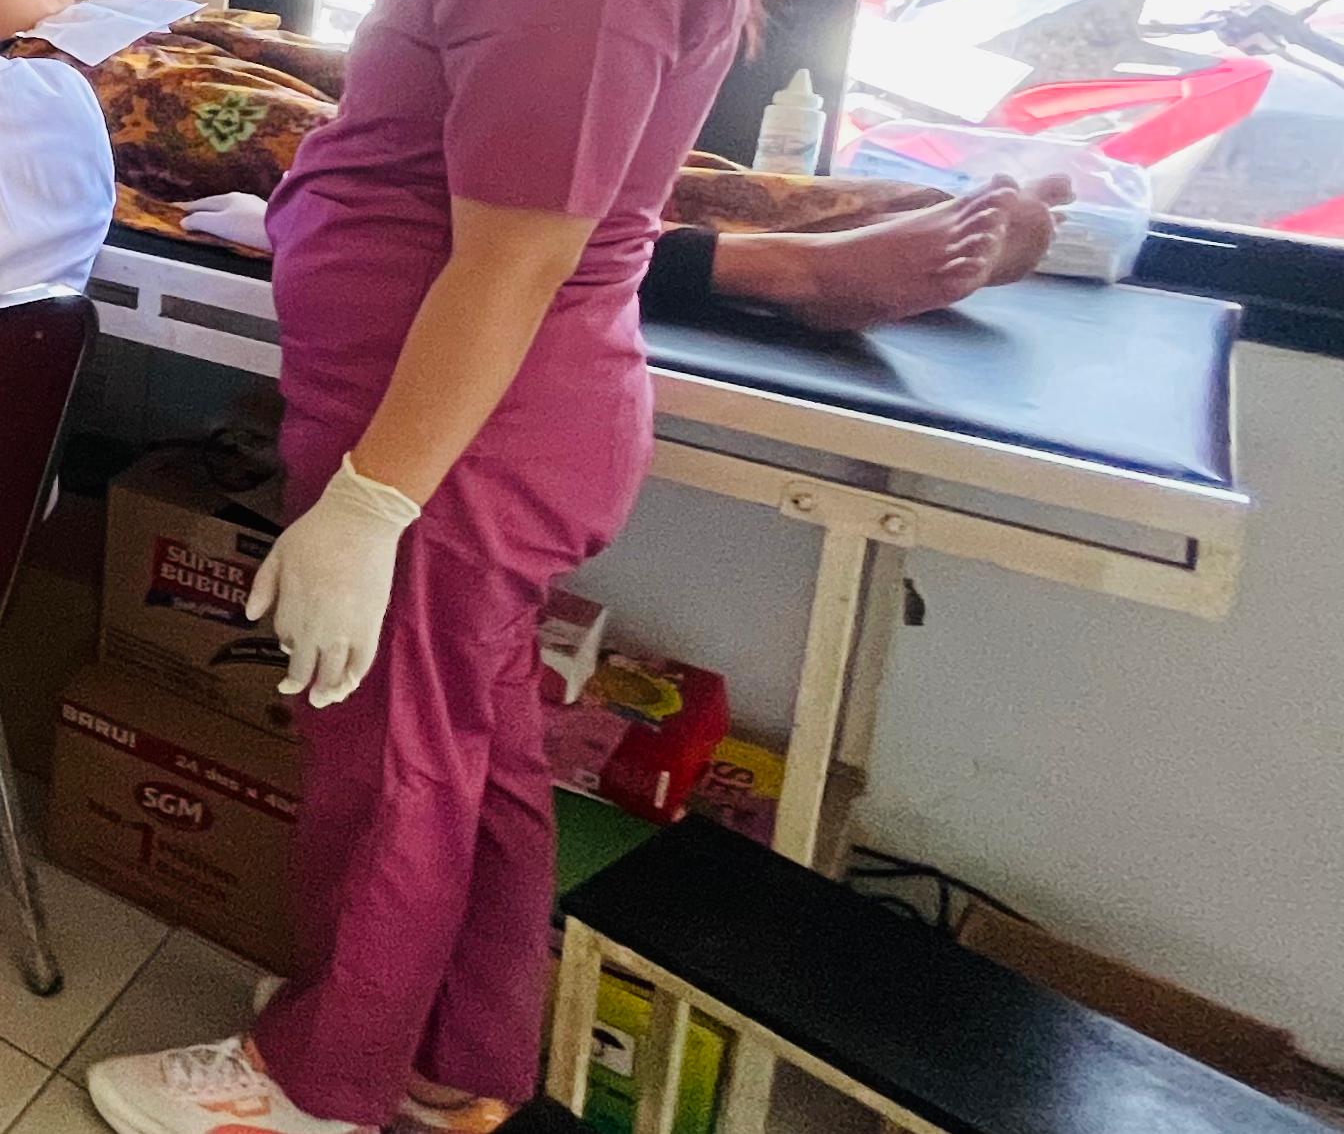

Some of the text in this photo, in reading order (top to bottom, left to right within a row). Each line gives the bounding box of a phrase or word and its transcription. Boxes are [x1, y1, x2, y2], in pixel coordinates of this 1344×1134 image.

[160, 564, 248, 607] BUBUR
[165, 545, 246, 585] SUPER
[62, 703, 137, 748] BARU!
[142, 787, 205, 824] SGM
